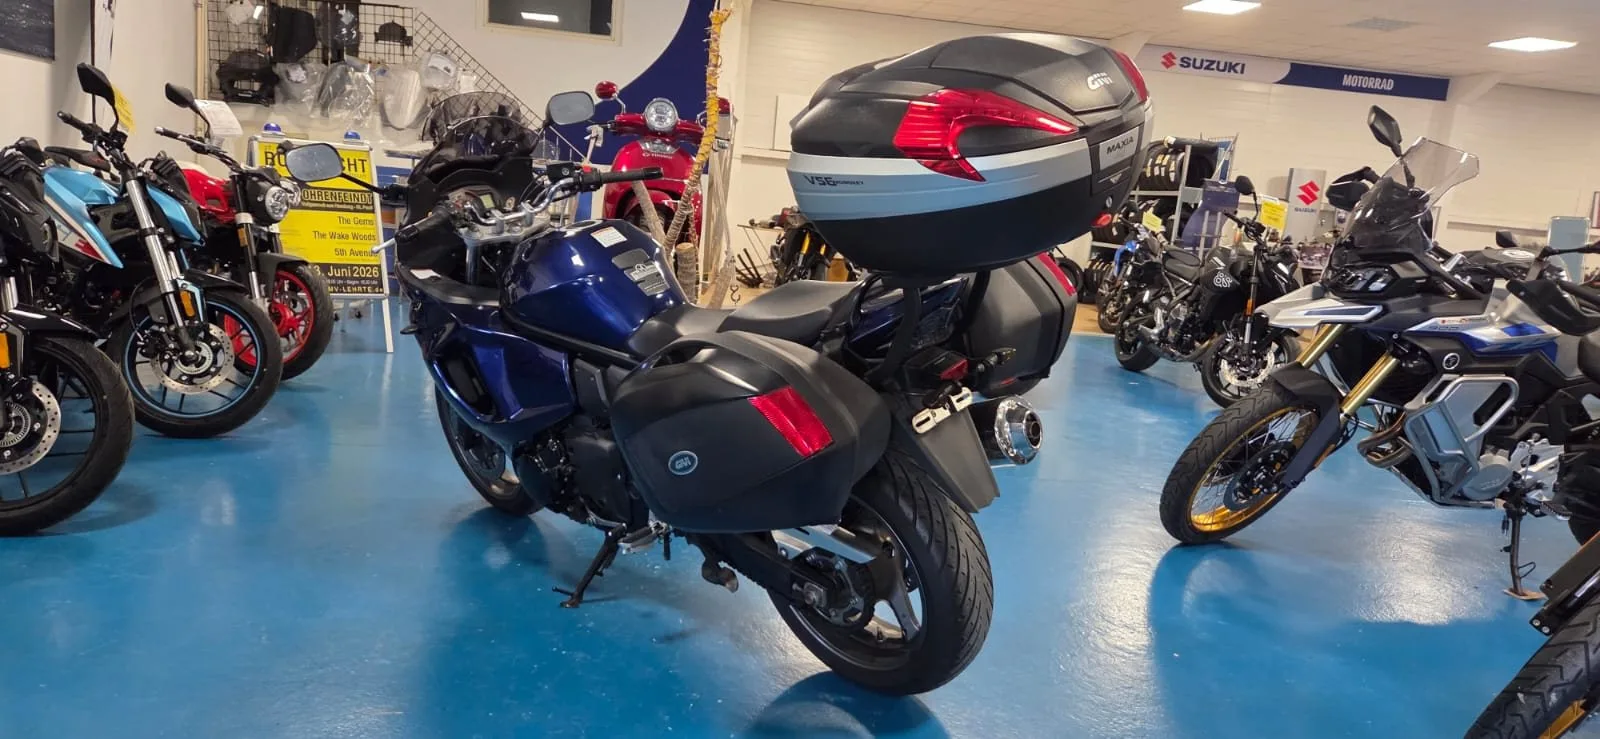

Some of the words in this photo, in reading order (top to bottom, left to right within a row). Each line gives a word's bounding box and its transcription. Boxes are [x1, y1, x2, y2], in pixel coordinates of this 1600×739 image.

[1179, 56, 1245, 75] SUZUKI
[1087, 72, 1113, 90] GIVI
[1342, 74, 1394, 91] MOTORRAD
[1106, 136, 1134, 155] MAXIA
[302, 189, 373, 205] OHRENFEINDT
[337, 216, 351, 225] The
[353, 217, 374, 226] Gems
[312, 231, 326, 240] The
[329, 232, 349, 240] Wake
[351, 232, 376, 241] Woods
[334, 248, 347, 257] 5th
[327, 265, 352, 277] Juni
[352, 266, 379, 278] 2026
